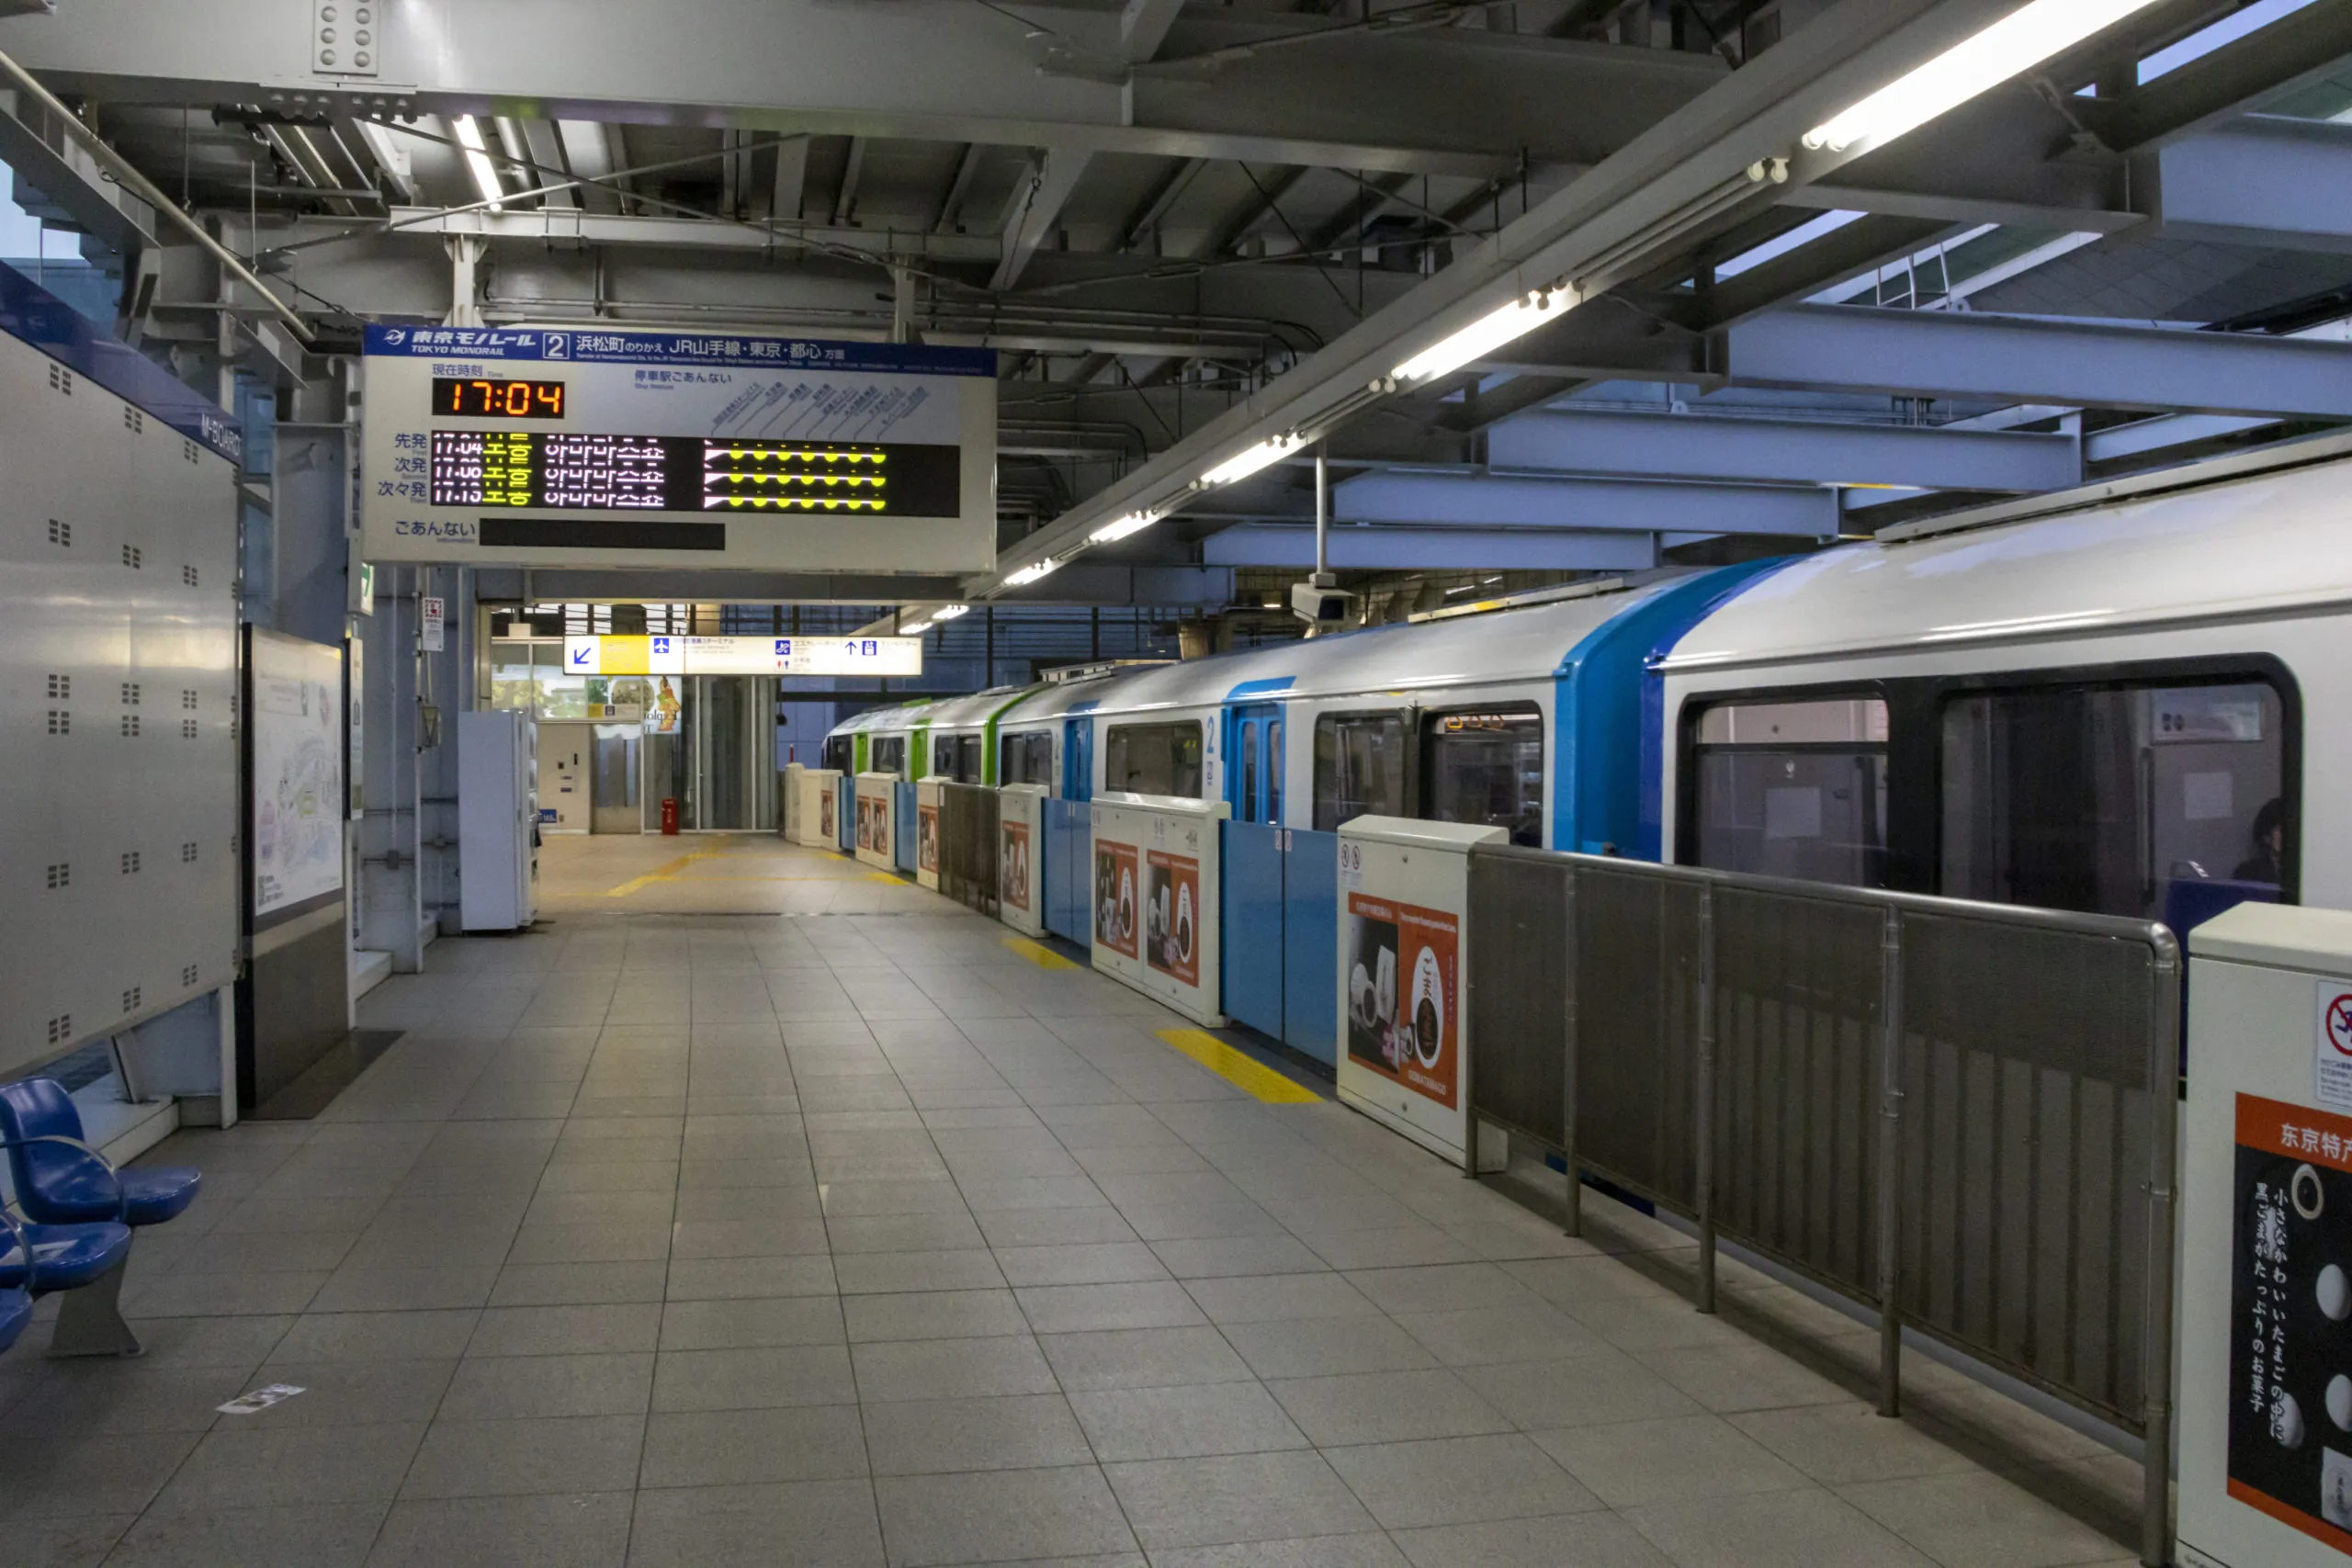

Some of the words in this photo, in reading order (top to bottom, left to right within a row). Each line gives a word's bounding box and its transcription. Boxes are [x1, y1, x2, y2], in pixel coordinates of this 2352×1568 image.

[412, 331, 536, 346] 東京モノレール
[548, 335, 563, 357] 2
[576, 335, 663, 353] 浜松町のりかえ
[412, 345, 448, 354] TOKYO
[450, 347, 504, 355] MONORAIL
[432, 364, 482, 377] 現在時刻
[453, 382, 560, 414] 17:04
[201, 412, 241, 457] M-BOARD
[395, 434, 426, 448] 先発
[395, 457, 426, 472] 次発
[378, 480, 426, 497] 次々発
[395, 521, 475, 536] ごあんない
[1206, 716, 1215, 754] 2
[2281, 1122, 2352, 1162] 东京特产
